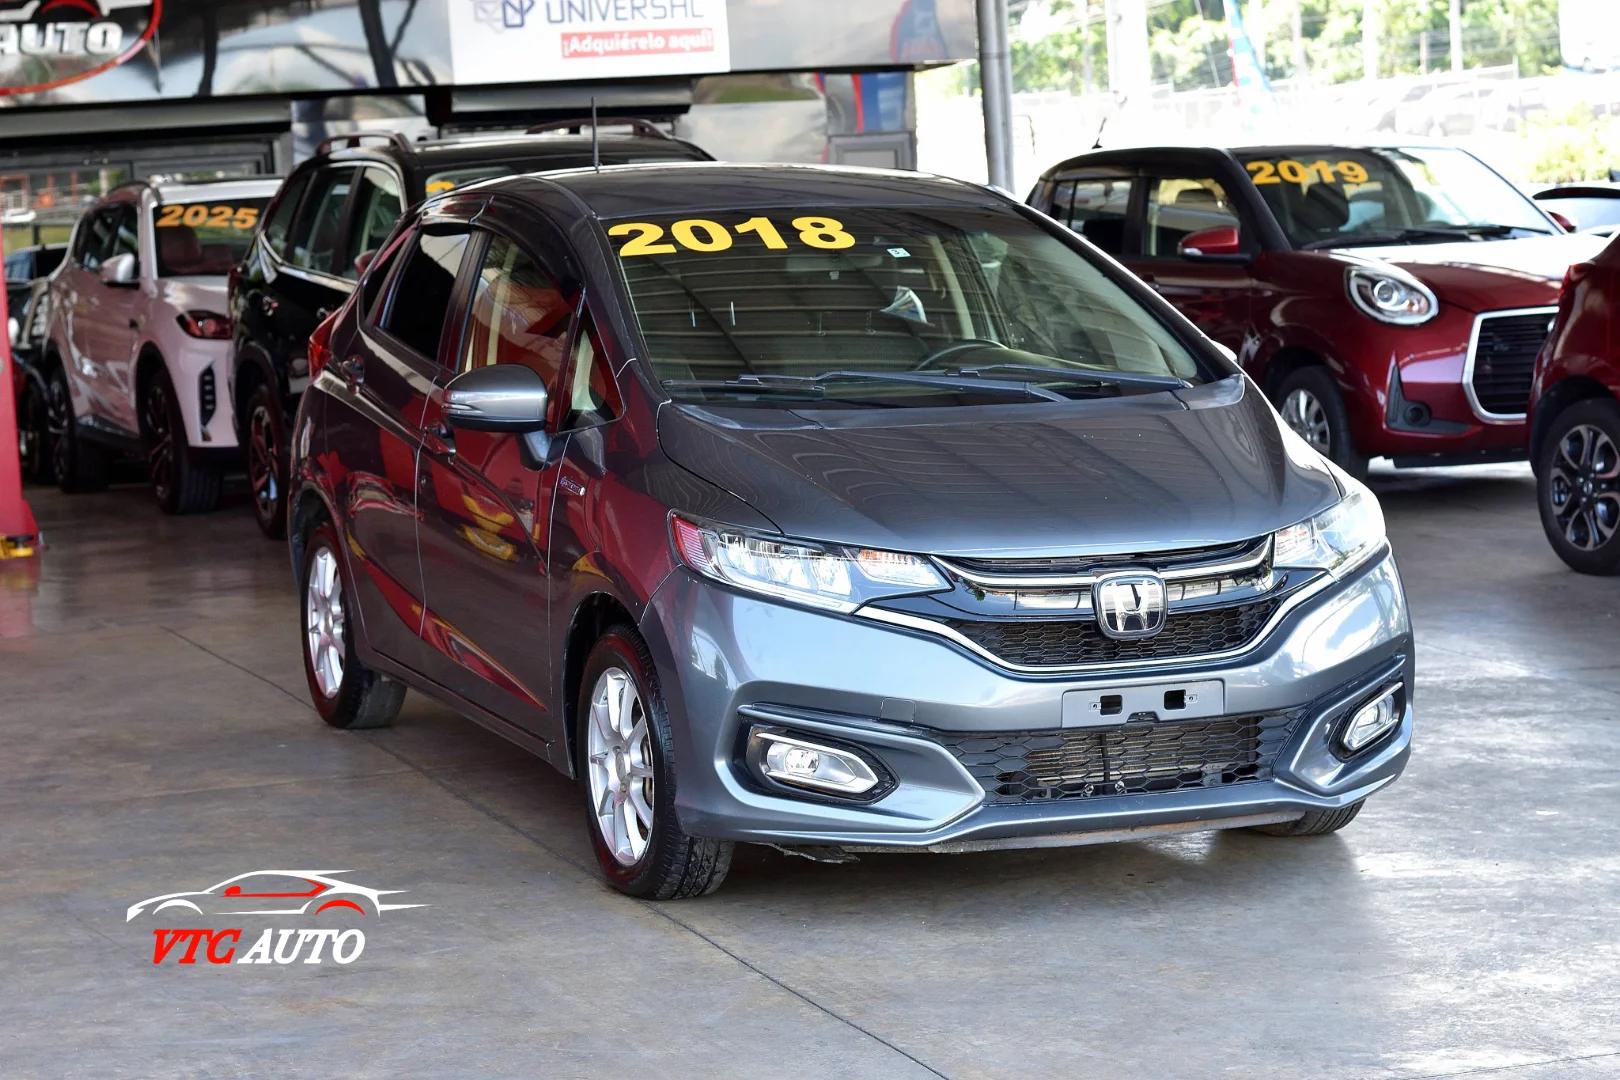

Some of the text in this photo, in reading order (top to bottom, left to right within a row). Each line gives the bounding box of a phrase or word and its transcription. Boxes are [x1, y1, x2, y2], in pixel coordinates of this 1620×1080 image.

[546, 0, 704, 23] UNIVERSAL
[1246, 160, 1369, 184] 2019
[156, 204, 259, 229] 2025
[608, 216, 856, 257] 2018
